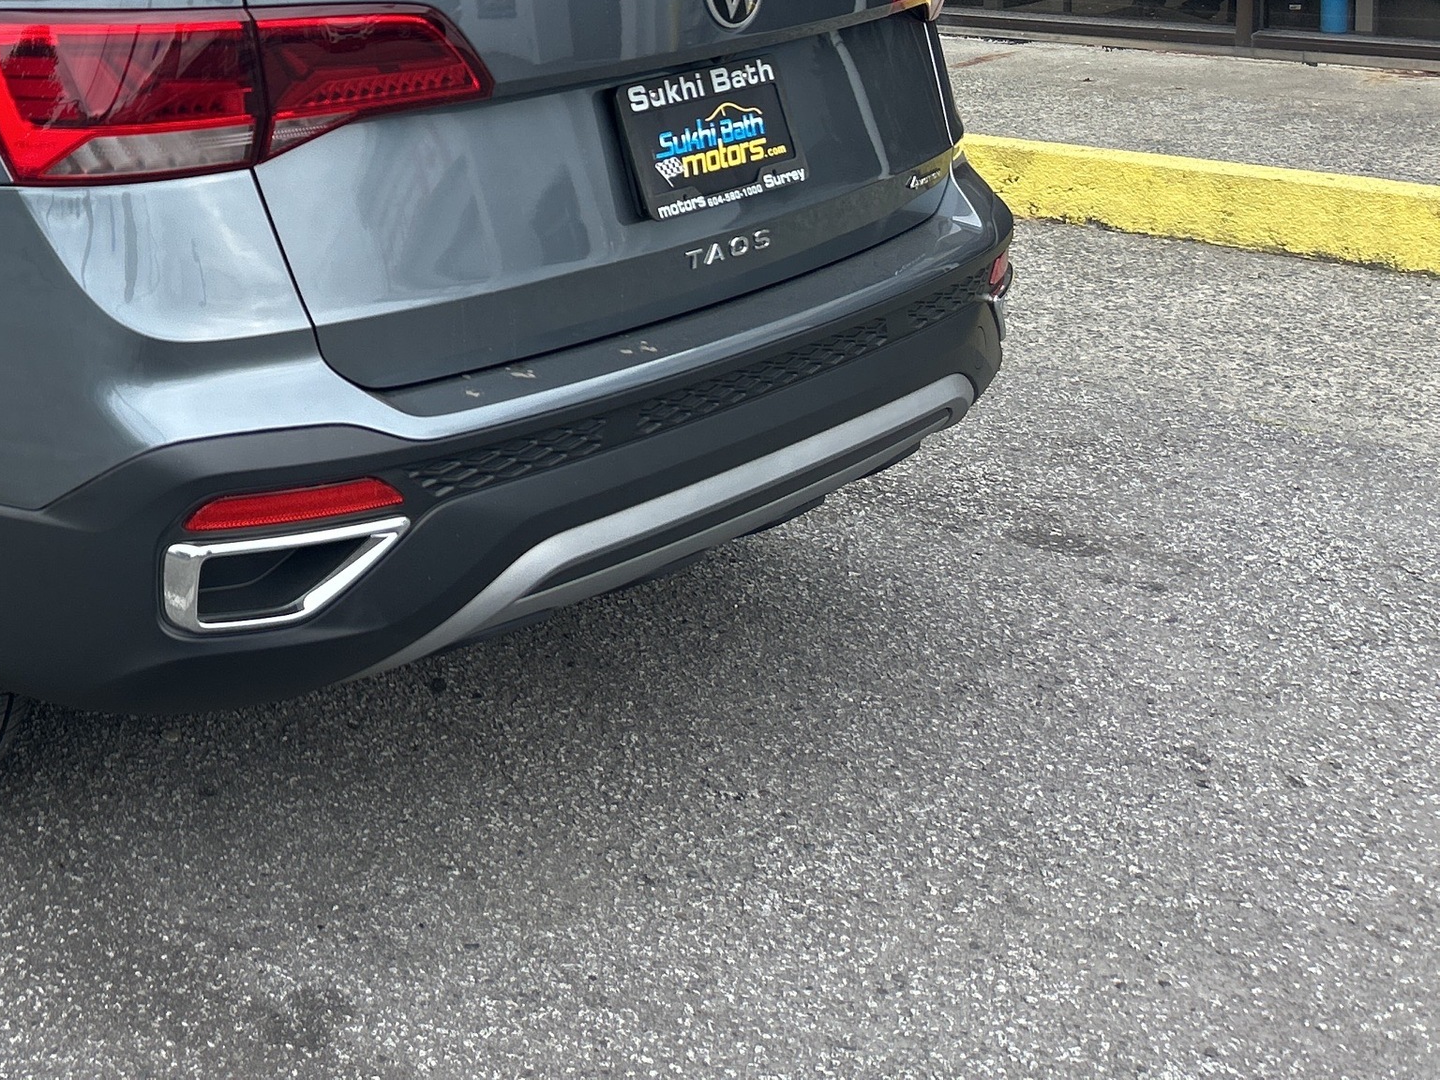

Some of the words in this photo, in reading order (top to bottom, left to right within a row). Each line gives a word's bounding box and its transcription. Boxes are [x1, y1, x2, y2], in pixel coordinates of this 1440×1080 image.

[627, 72, 706, 112] Sukhi
[710, 59, 775, 94] Bath
[655, 118, 716, 159] Sukhi
[719, 113, 766, 142] Bath
[657, 194, 708, 219] motors
[762, 167, 806, 190] Surrey
[685, 229, 771, 270] TAOS
